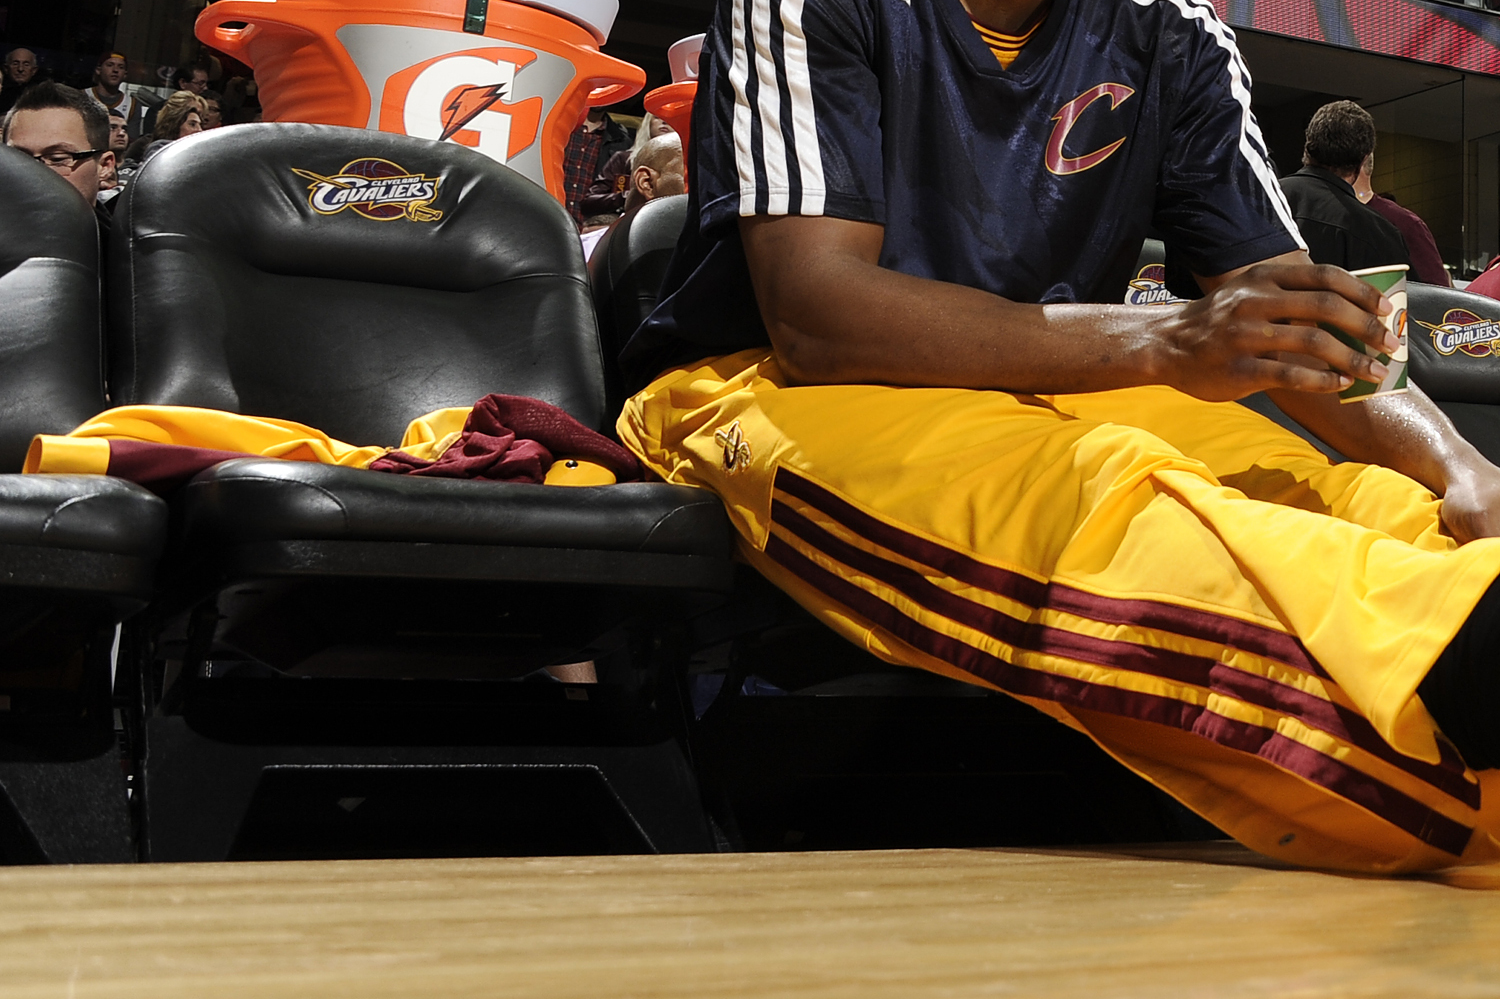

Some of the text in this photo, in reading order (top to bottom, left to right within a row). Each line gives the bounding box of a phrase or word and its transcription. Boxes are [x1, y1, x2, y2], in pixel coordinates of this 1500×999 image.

[403, 55, 516, 166] G
[1045, 82, 1135, 176] C
[313, 177, 434, 211] CAVALIERS
[371, 176, 420, 187] CLEVELAND
